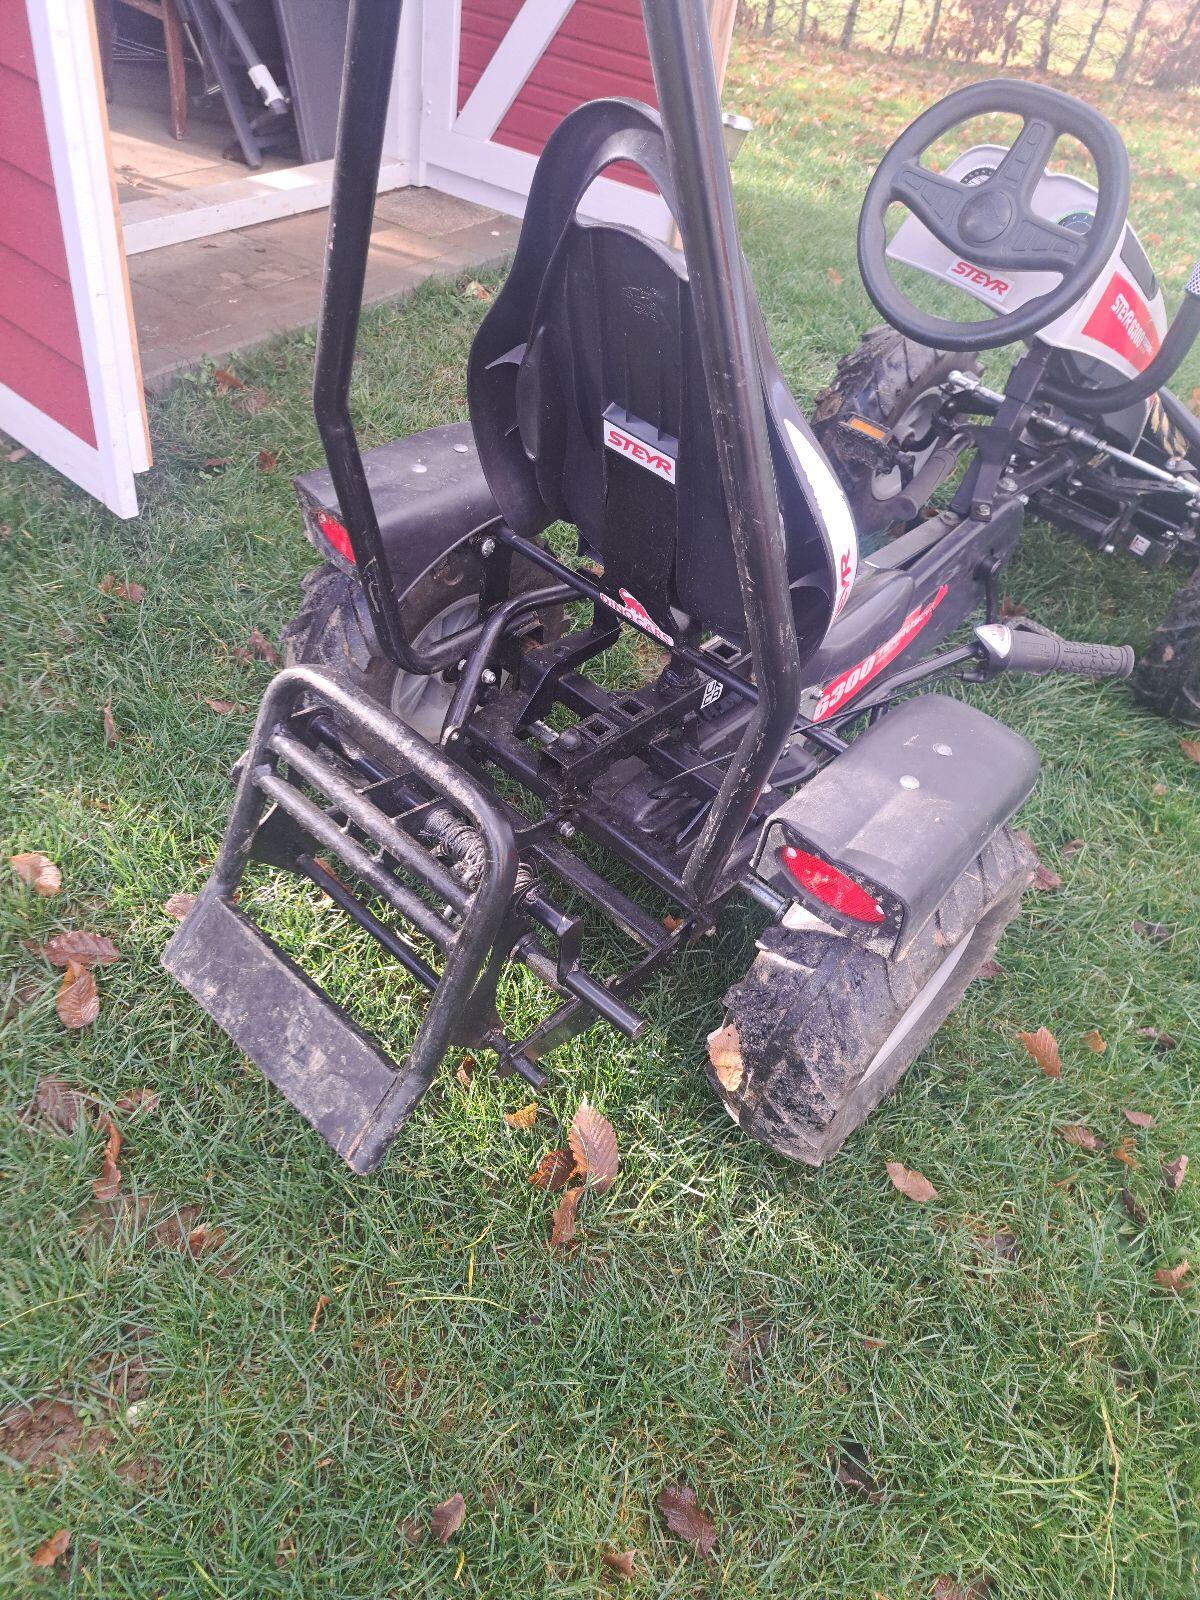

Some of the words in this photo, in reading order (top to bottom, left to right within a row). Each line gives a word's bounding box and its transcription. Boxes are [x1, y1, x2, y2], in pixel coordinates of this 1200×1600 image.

[951, 261, 1009, 296] STEYR
[1110, 293, 1135, 330] STEYR
[608, 430, 672, 476] STEYR
[636, 616, 672, 645] CARS
[813, 655, 876, 721] 6300
